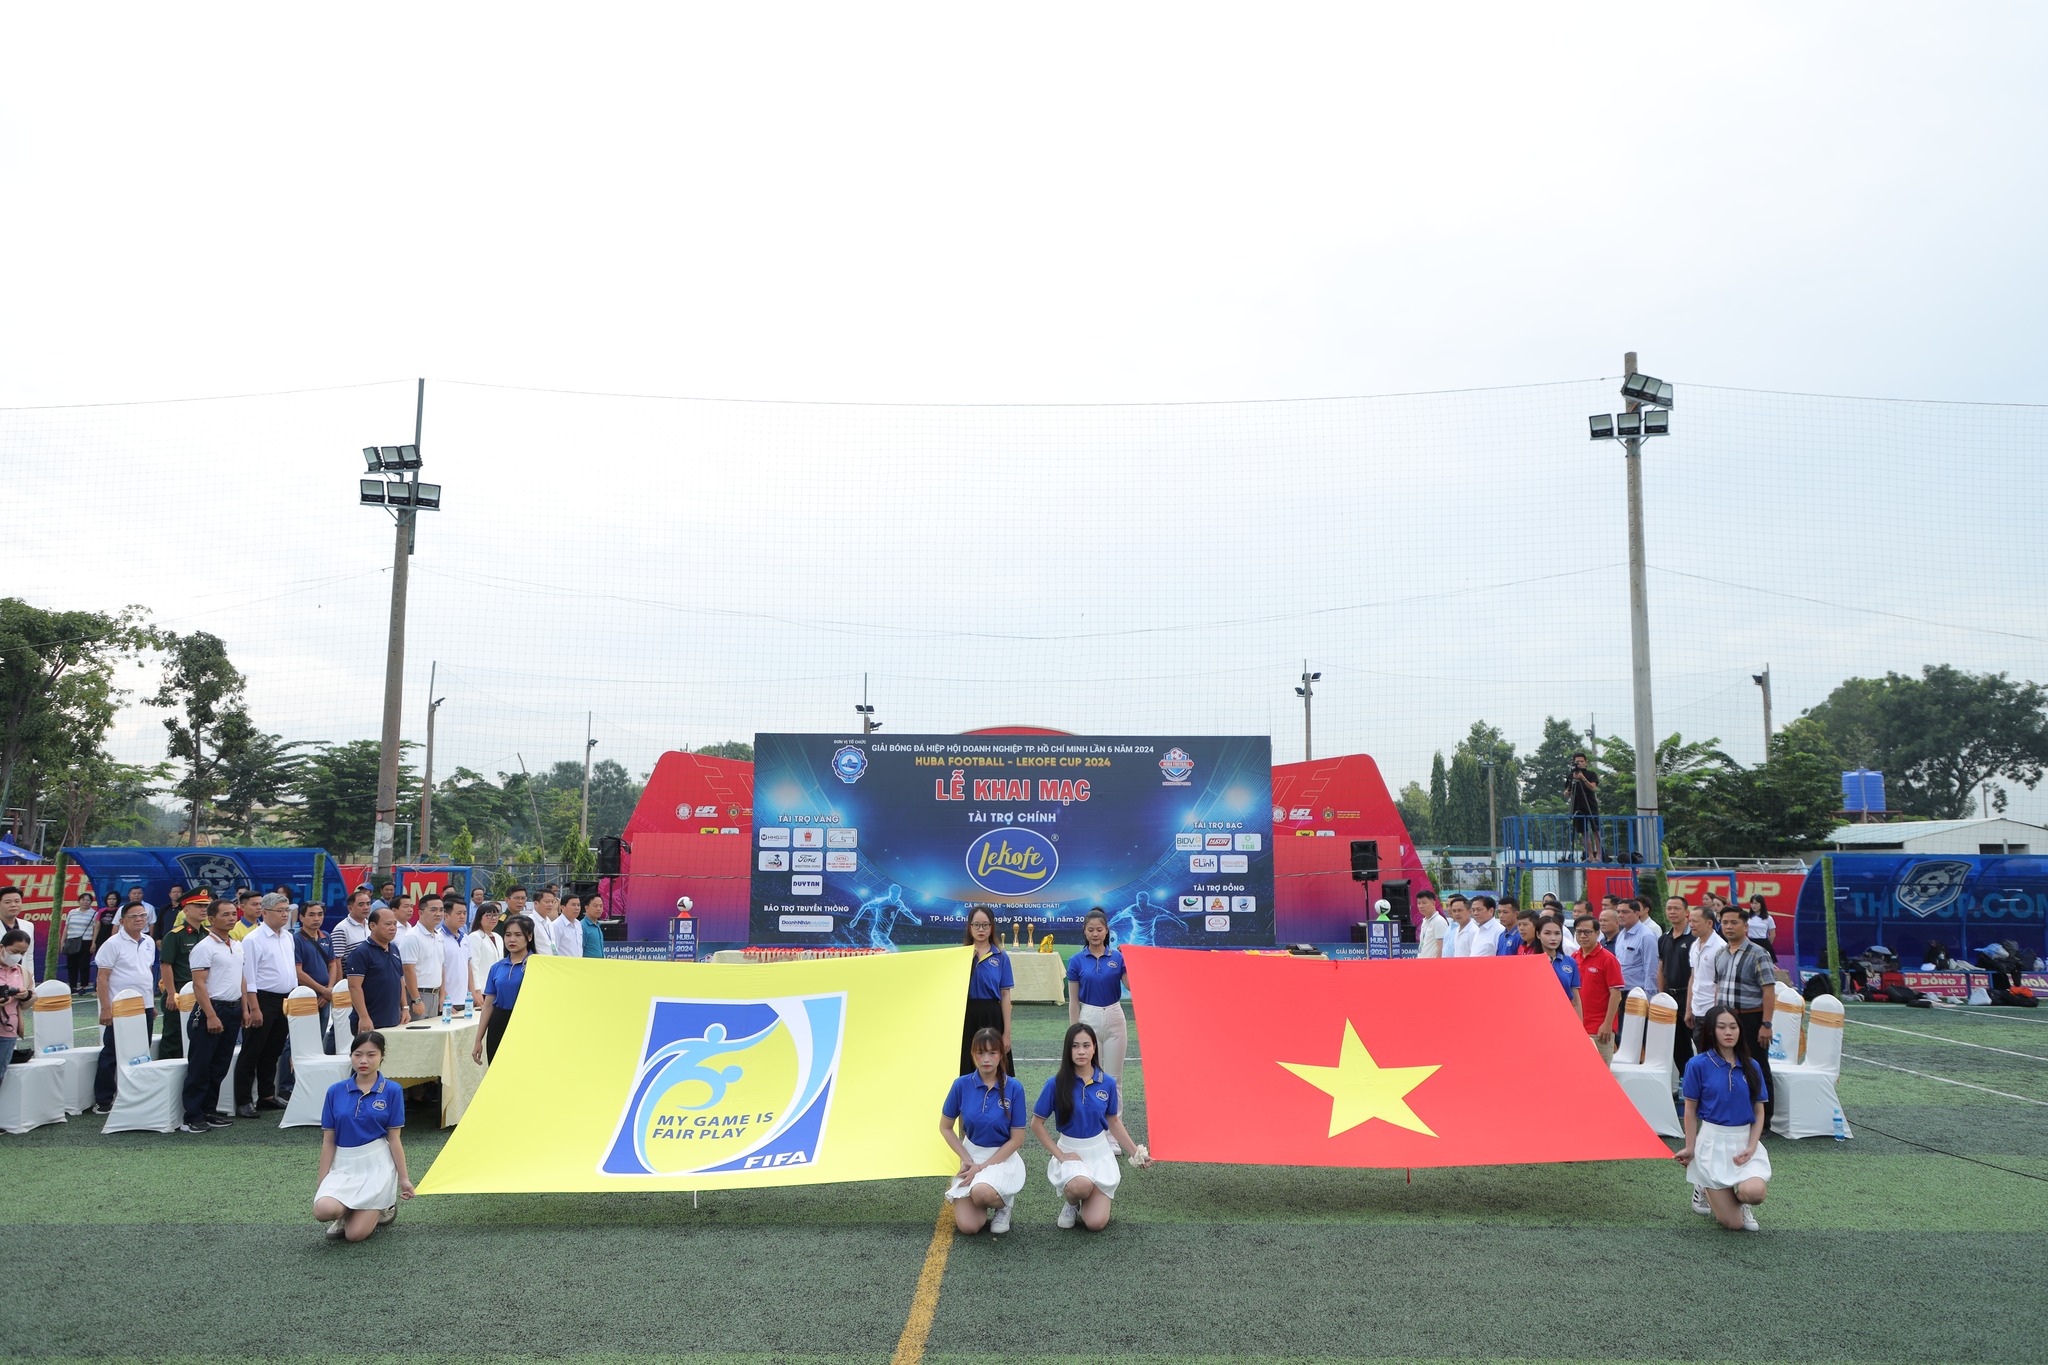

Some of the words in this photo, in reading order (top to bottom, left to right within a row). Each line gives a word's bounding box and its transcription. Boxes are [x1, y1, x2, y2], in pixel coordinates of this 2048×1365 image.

[871, 742, 888, 752] GIẢI
[889, 743, 912, 753] BÓNG
[913, 743, 925, 753] ĐÁ
[926, 744, 945, 754] HIỆP
[947, 743, 961, 754] HỘI
[963, 745, 991, 753] DOANH
[992, 744, 1023, 754] NGHIỆP
[1024, 745, 1036, 753] TP.
[1037, 742, 1049, 753] HỒ
[1050, 743, 1065, 753] CHÍ
[1066, 745, 1088, 753] MINH
[1089, 742, 1106, 753] LẦN
[1114, 744, 1133, 753] NĂM
[915, 756, 946, 766] HUBA
[948, 756, 1005, 766] FOOTBALL
[1016, 757, 1057, 767] LEKOFE
[1059, 757, 1082, 767] CUP
[1084, 757, 1111, 767] 2024
[935, 769, 966, 801] LỄ
[973, 779, 1031, 801] KHAI
[1039, 779, 1091, 806] MẠC
[778, 814, 792, 823] TÀI
[794, 815, 811, 825] TRỢ
[813, 814, 840, 823] VÀNG
[968, 810, 987, 823] TÀI
[990, 811, 1014, 825] TRỢ
[1017, 810, 1057, 823] CHÍNH
[1193, 821, 1206, 829] TÀI
[1208, 822, 1224, 830] TRỢ
[1226, 822, 1243, 830] BẠC
[797, 854, 818, 863] Ford
[977, 840, 1047, 880] Lekofe
[1206, 884, 1221, 892] TRỢ
[1222, 882, 1245, 891] ĐỒNG
[763, 903, 779, 912] BẢO
[780, 904, 795, 913] TRỢ
[796, 903, 823, 912] TRUYỀN
[823, 903, 850, 912] THÔNG
[1024, 915, 1047, 923] tháng
[610, 945, 619, 953] ĐÁ
[620, 945, 634, 953] HIỆP
[1335, 947, 1348, 955] GIẢI
[652, 953, 667, 961] NĂM
[1920, 974, 1957, 986] ĐÔNG
[656, 1114, 689, 1127] MY
[693, 1113, 751, 1127] GAME
[755, 1111, 775, 1124] IS
[651, 1127, 694, 1140] FAIR
[698, 1127, 747, 1140] PLAY
[743, 1150, 808, 1169] FIFA
